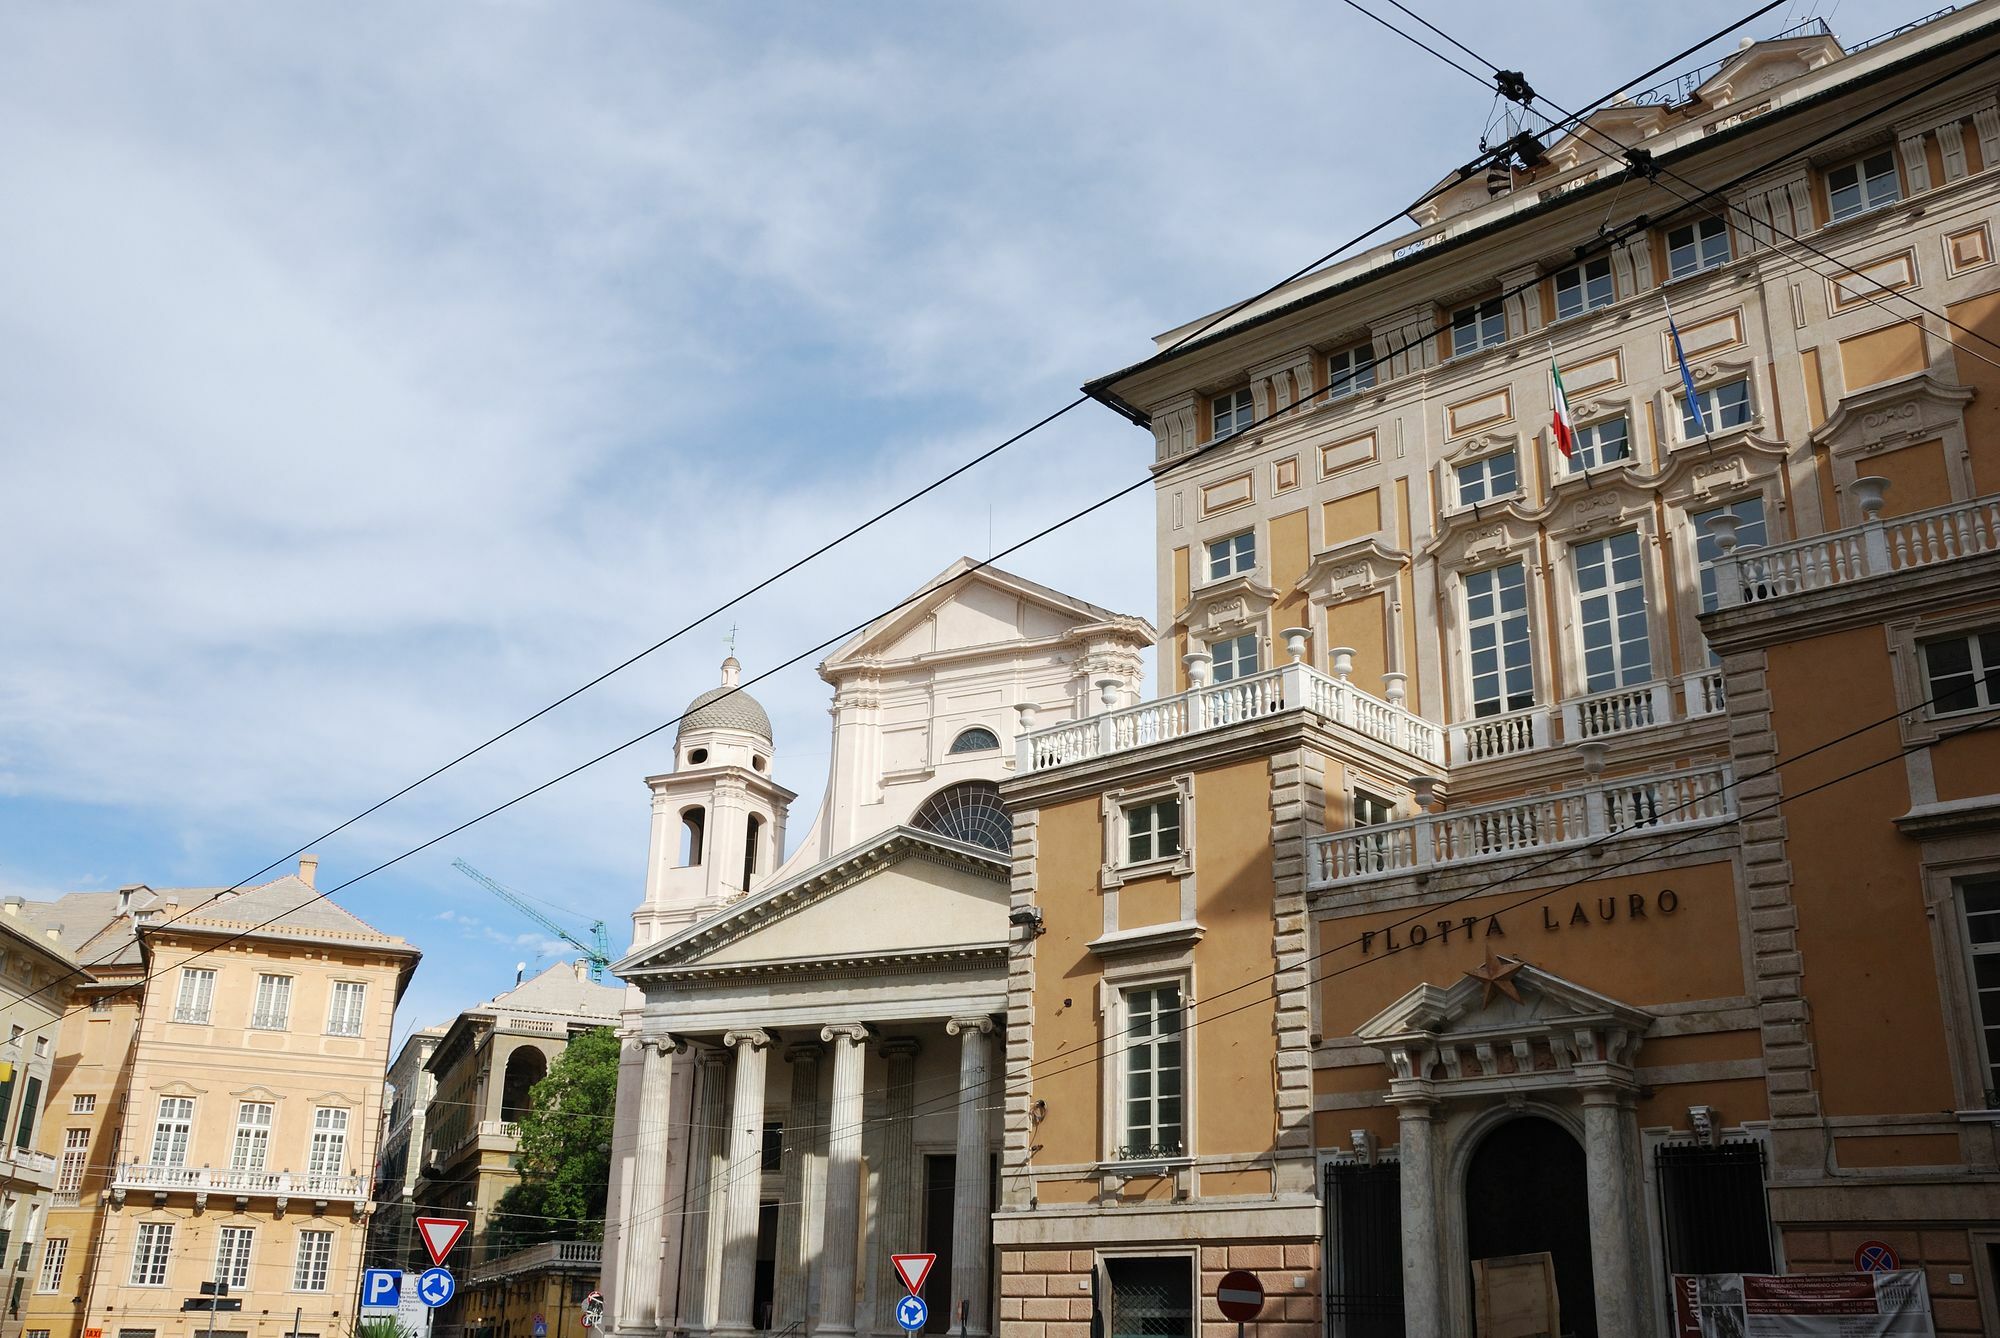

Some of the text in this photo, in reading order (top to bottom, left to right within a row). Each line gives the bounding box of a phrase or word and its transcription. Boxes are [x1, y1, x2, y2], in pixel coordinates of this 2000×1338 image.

[1361, 889, 1679, 954] FLOTTA LAURO
[370, 1273, 394, 1303] P
[1685, 1278, 1701, 1333] Lauro
